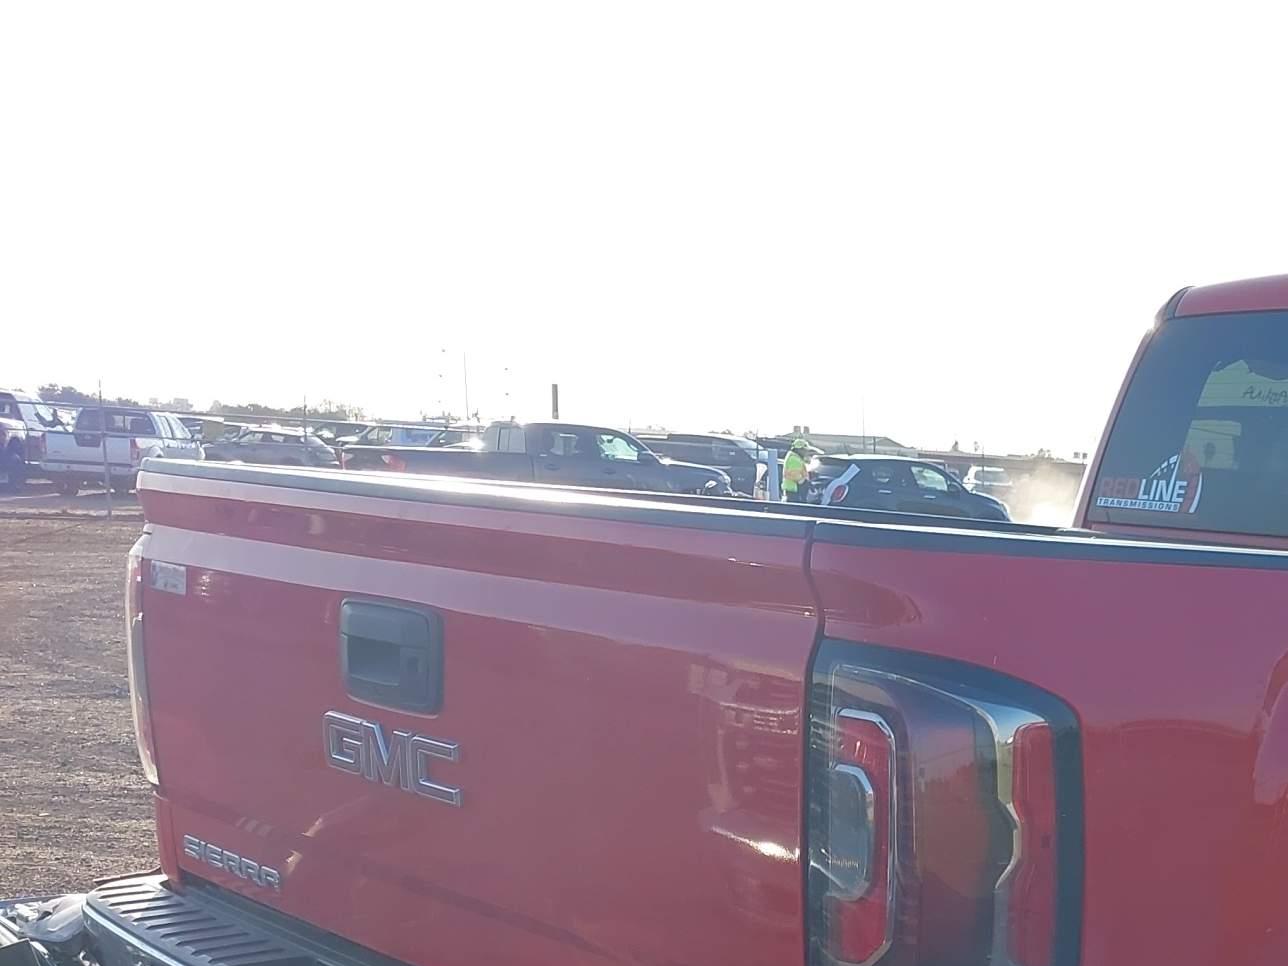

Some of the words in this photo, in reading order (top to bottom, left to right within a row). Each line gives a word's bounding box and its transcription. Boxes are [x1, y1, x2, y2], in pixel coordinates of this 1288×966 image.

[1096, 497, 1180, 513] TRANSMISSIONS
[322, 710, 464, 808] GMC
[183, 833, 281, 892] SIERRA
